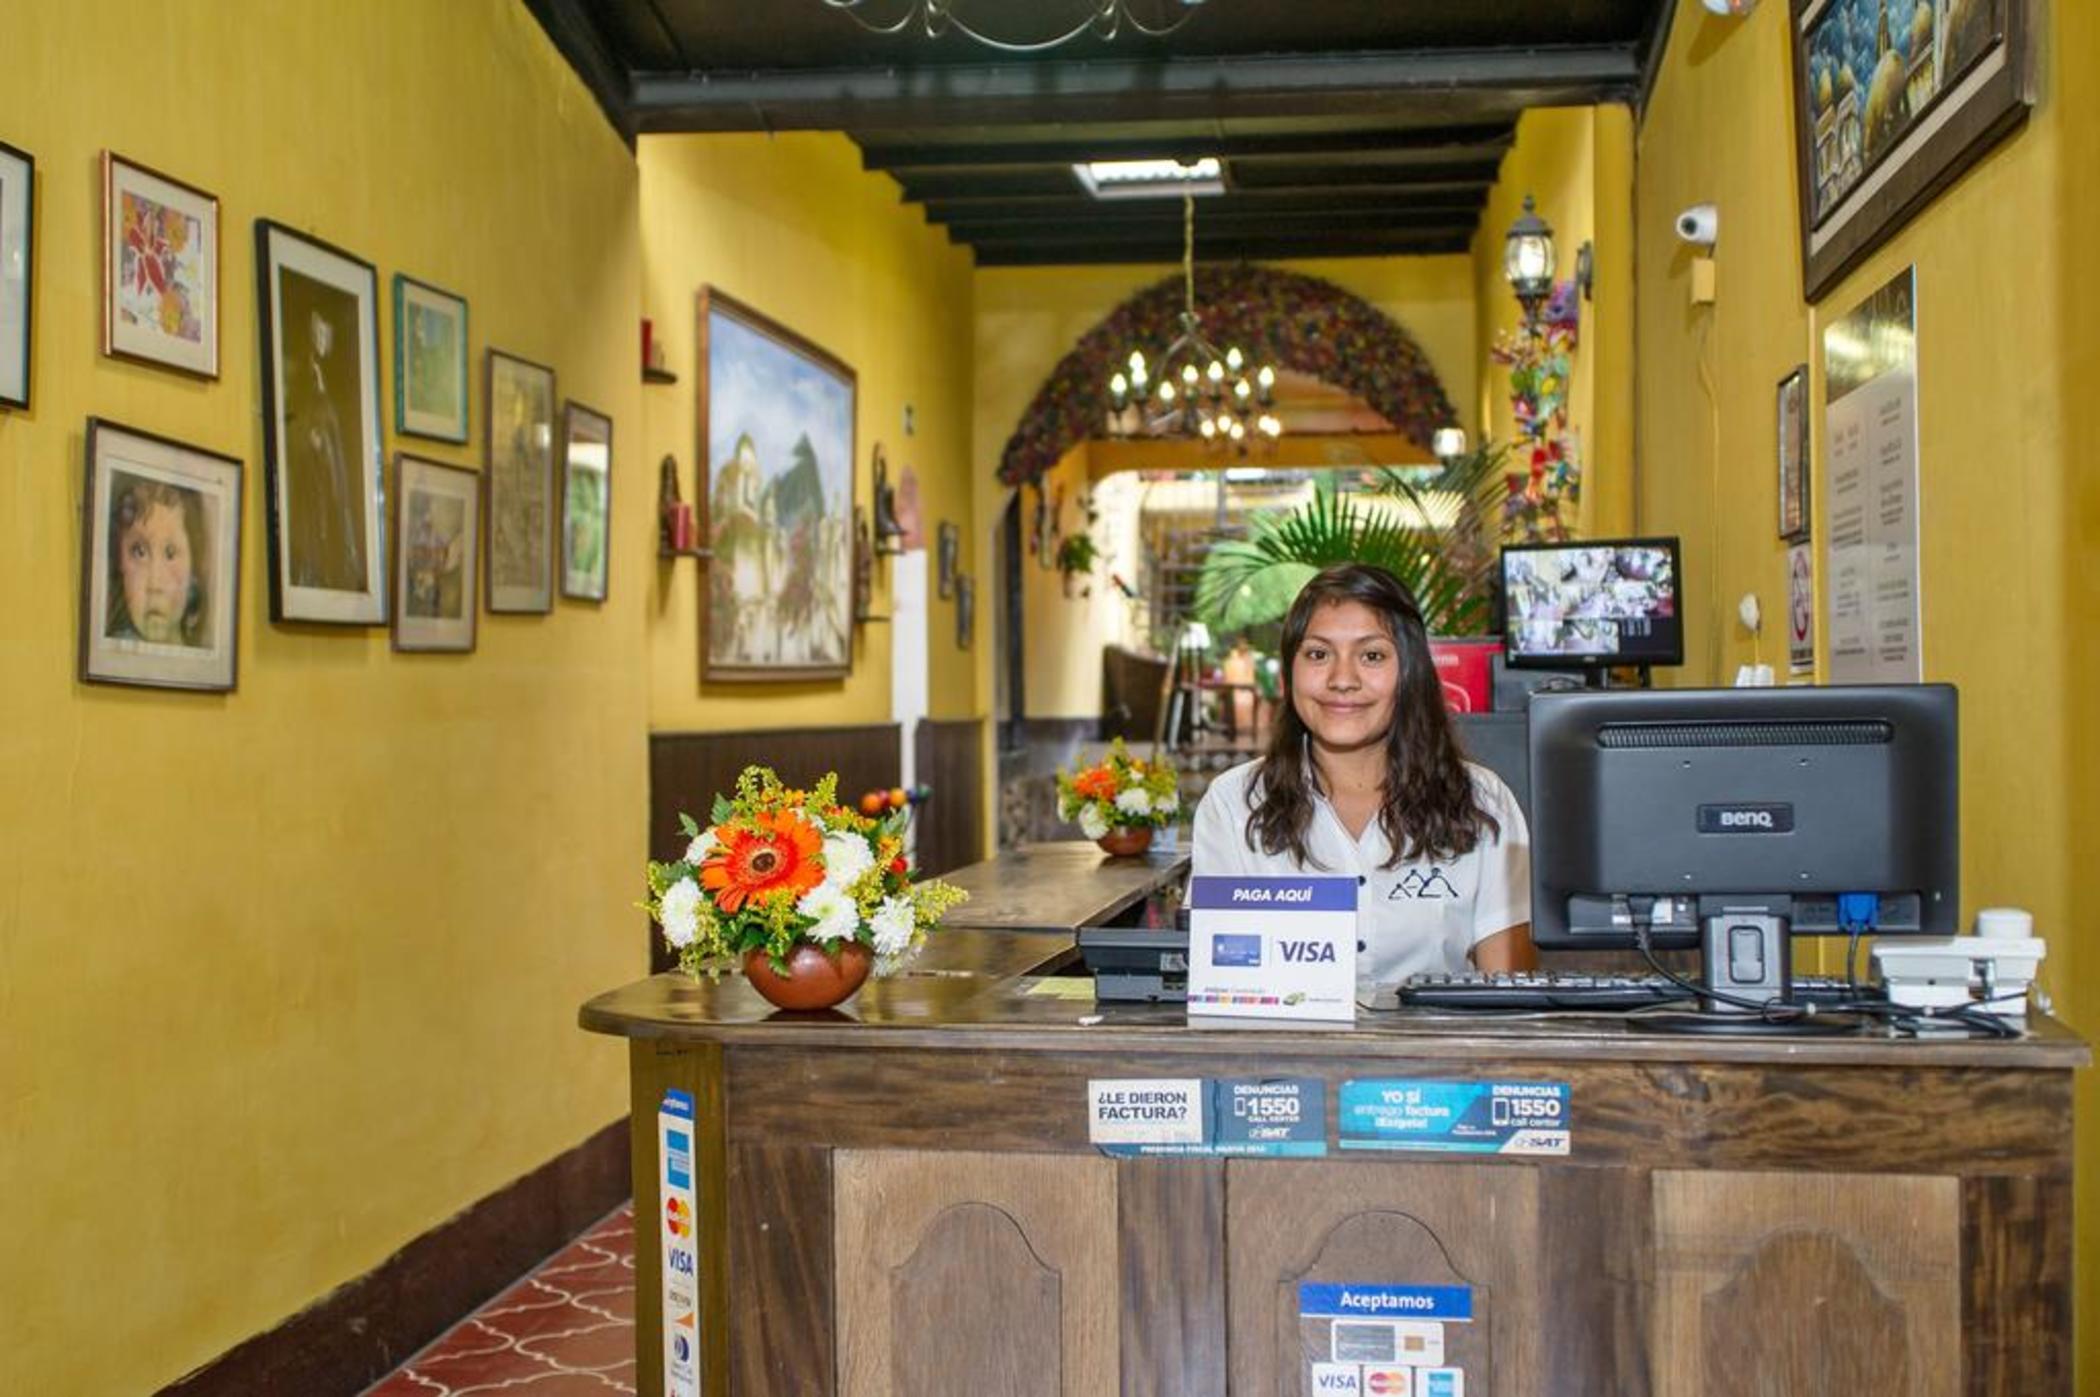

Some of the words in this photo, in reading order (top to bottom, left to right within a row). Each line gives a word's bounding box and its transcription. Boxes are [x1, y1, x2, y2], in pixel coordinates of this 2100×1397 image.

[1232, 887, 1271, 902] PAGA
[1275, 886, 1313, 902] AQUÍ
[1278, 940, 1336, 963] VISA
[1234, 1085, 1299, 1095] DENUNCIAS
[1382, 1090, 1403, 1103] YO
[1492, 1085, 1560, 1097] DENUNCIAS
[1099, 1091, 1125, 1105] ¿LE
[1129, 1091, 1187, 1105] DIERON
[1099, 1106, 1187, 1120] FACTURA?
[1247, 1097, 1300, 1116] 1550
[1405, 1105, 1450, 1117] factura
[1511, 1098, 1561, 1117] 1550
[1529, 1138, 1565, 1148] SAT
[668, 1246, 694, 1277] VISA
[1340, 1290, 1434, 1312] Aceptamos
[1319, 1374, 1356, 1389] VISA
